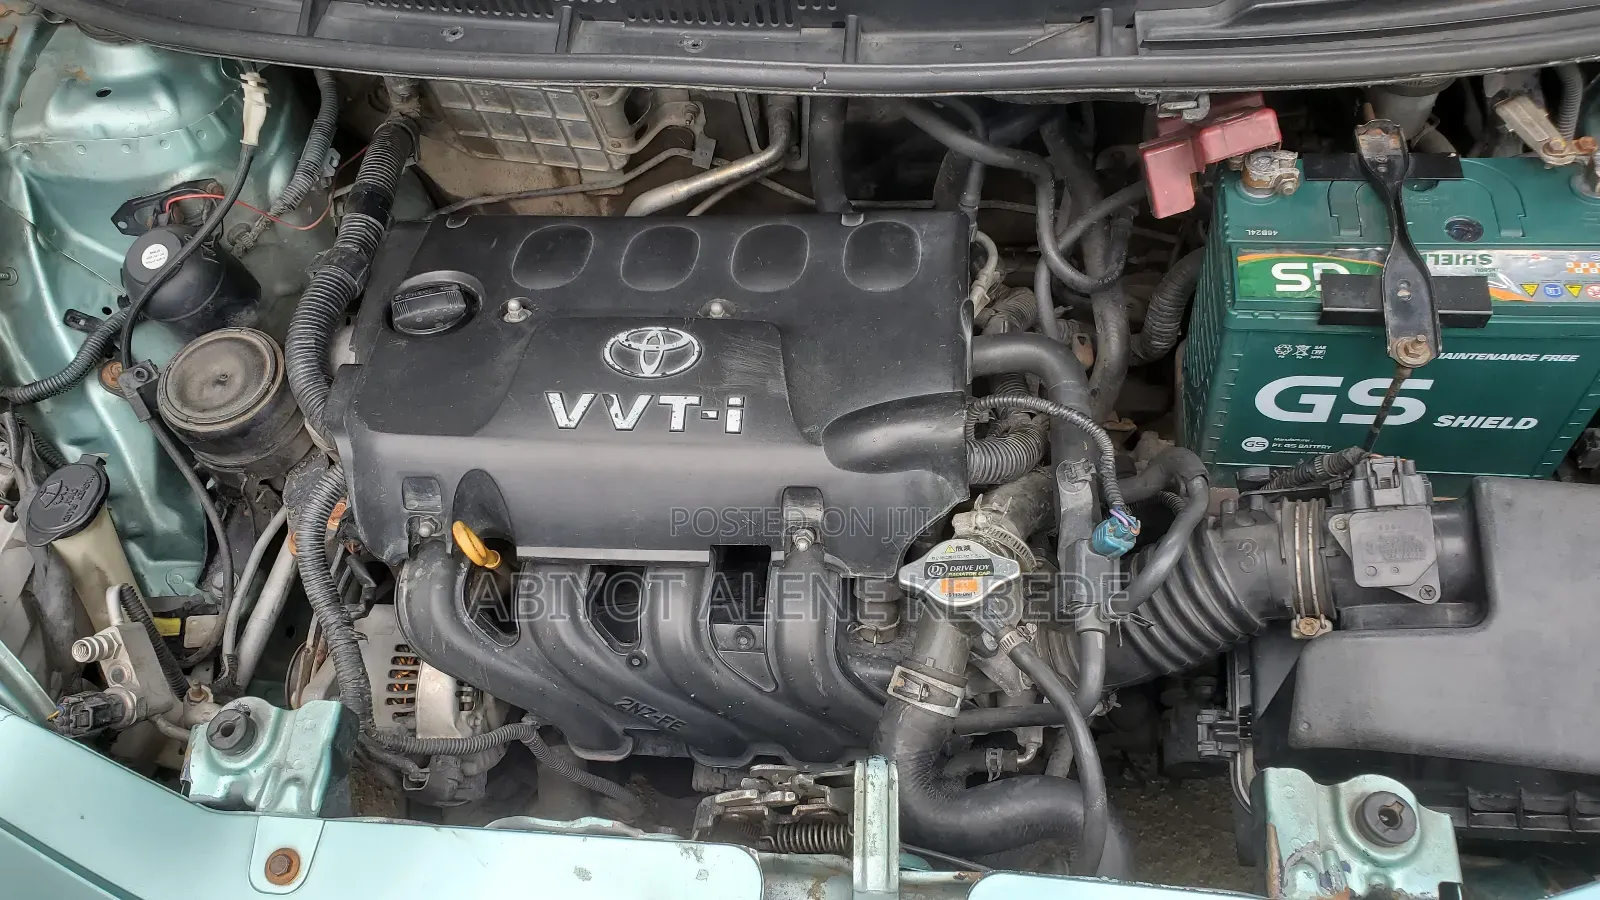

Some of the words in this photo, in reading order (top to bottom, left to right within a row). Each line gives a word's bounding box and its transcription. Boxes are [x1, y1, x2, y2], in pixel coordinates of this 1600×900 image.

[1539, 354, 1580, 362] FREE
[545, 391, 745, 434] VVT-i
[1254, 375, 1434, 426] GS
[1433, 414, 1539, 430] SHIELD
[949, 564, 975, 572] DRIVE
[614, 696, 688, 732] 2NZ-FE
